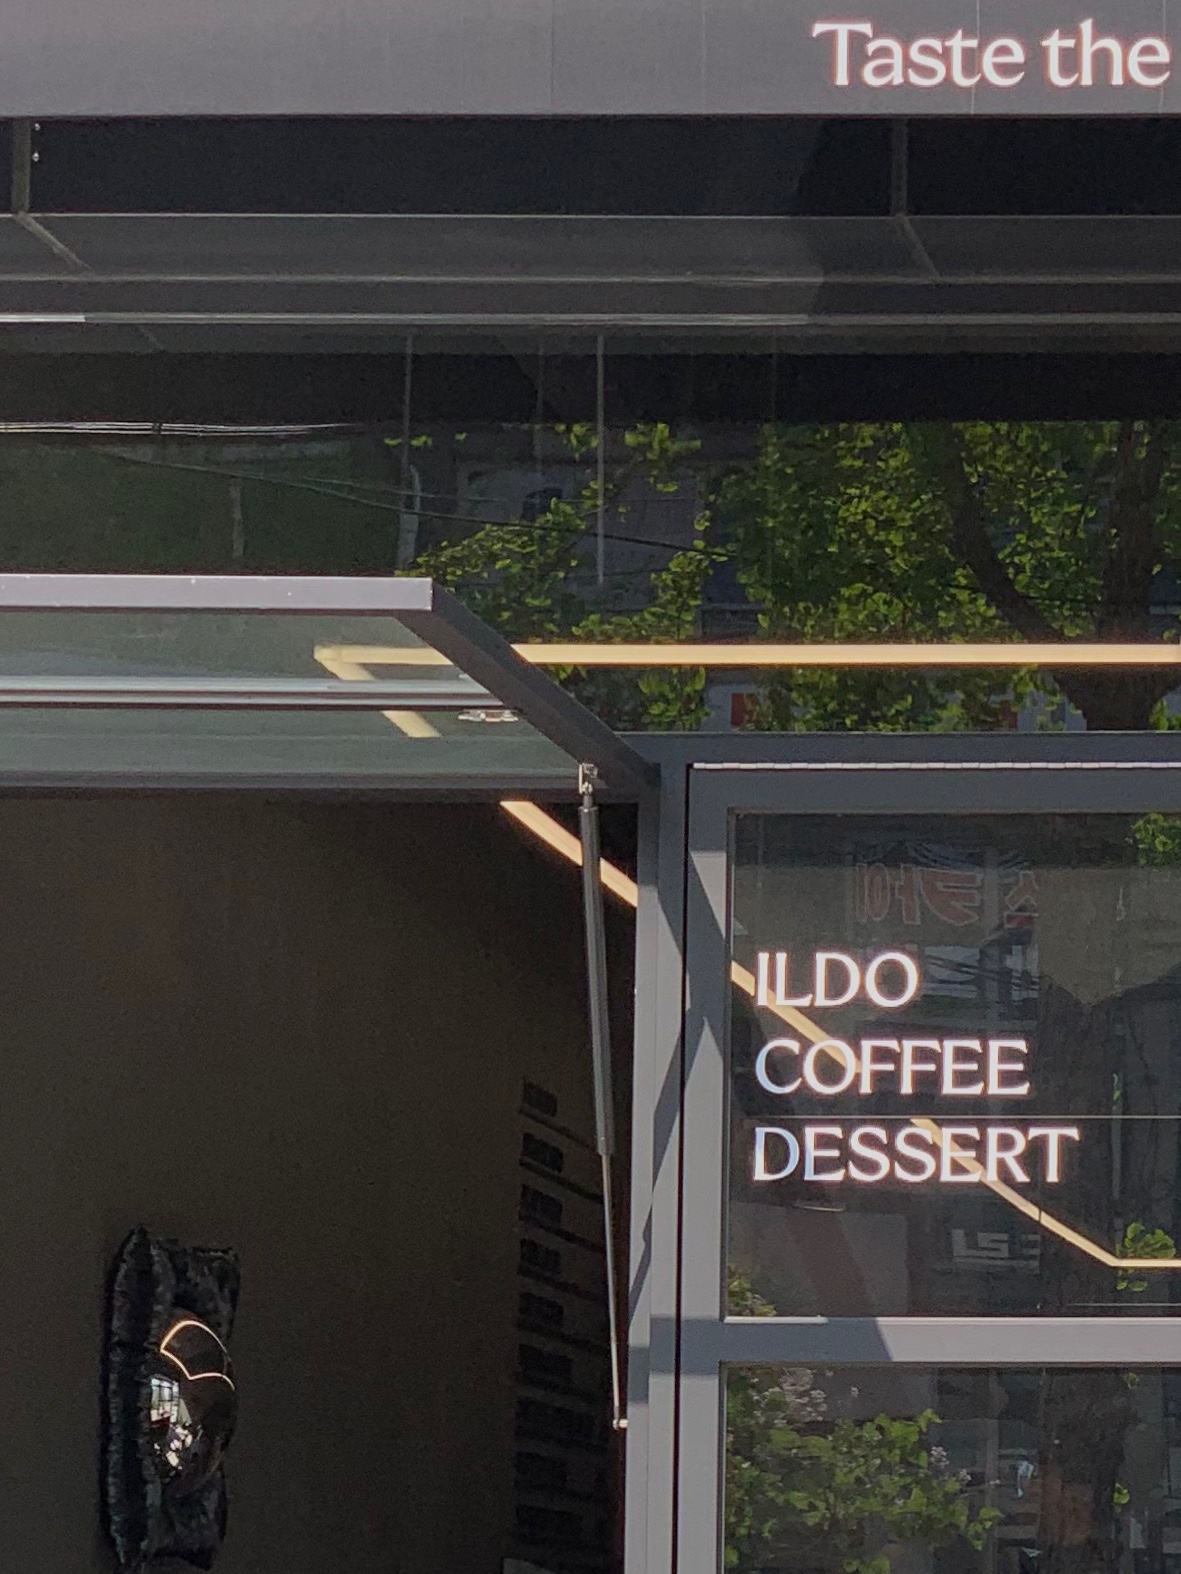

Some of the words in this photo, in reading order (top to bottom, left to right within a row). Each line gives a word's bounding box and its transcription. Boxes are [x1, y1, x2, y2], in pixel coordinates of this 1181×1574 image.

[812, 22, 1025, 88] Taste
[1041, 18, 1171, 87] the
[755, 952, 919, 1006] ILDO
[755, 1039, 1031, 1095] COFFEE
[753, 1126, 1080, 1183] DESSERT
